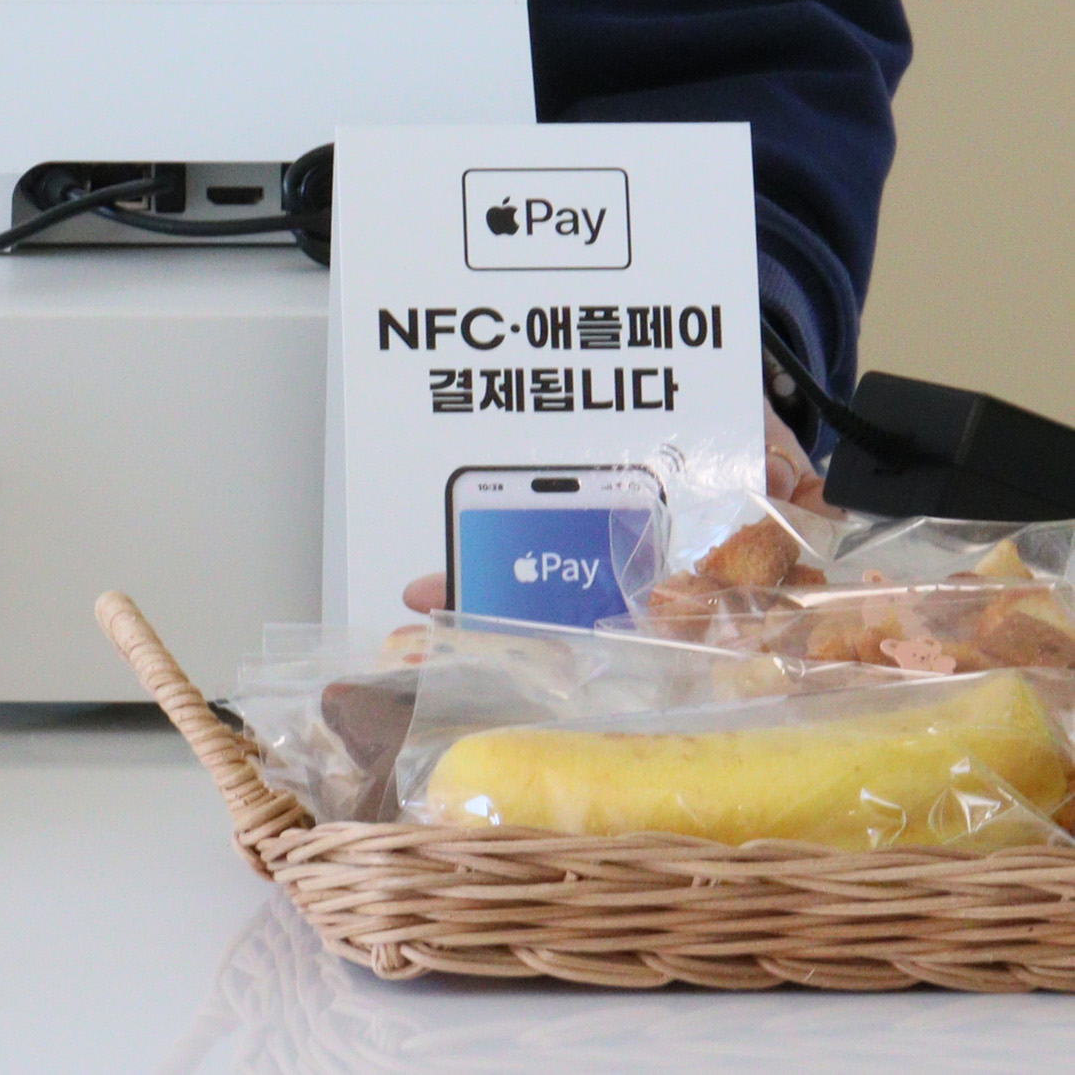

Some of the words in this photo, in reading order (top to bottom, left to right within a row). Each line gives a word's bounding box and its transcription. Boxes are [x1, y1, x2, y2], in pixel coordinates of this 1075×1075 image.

[525, 198, 607, 245] Pay
[378, 304, 723, 351] NFC·애플페이
[428, 367, 679, 413] 결제됩니다
[541, 552, 600, 589] Pay
